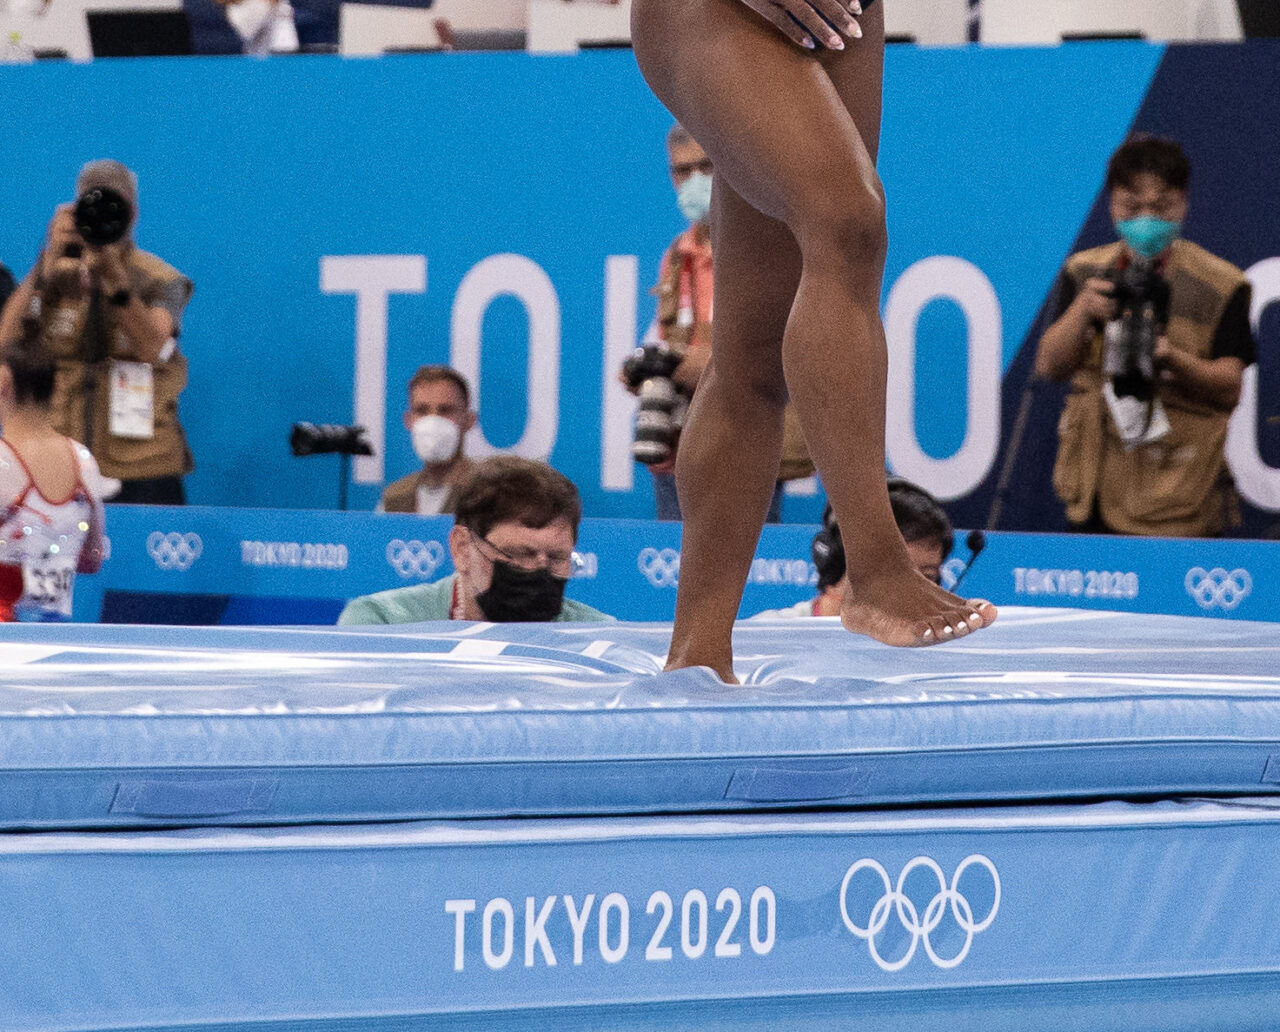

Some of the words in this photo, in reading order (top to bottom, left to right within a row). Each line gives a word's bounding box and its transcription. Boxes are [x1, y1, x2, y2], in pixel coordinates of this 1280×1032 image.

[319, 254, 1002, 501] TOO
[1013, 568, 1083, 596] TOKYO
[1085, 571, 1138, 599] 2020
[444, 892, 631, 971] TOKYO
[645, 885, 777, 961] 2020
